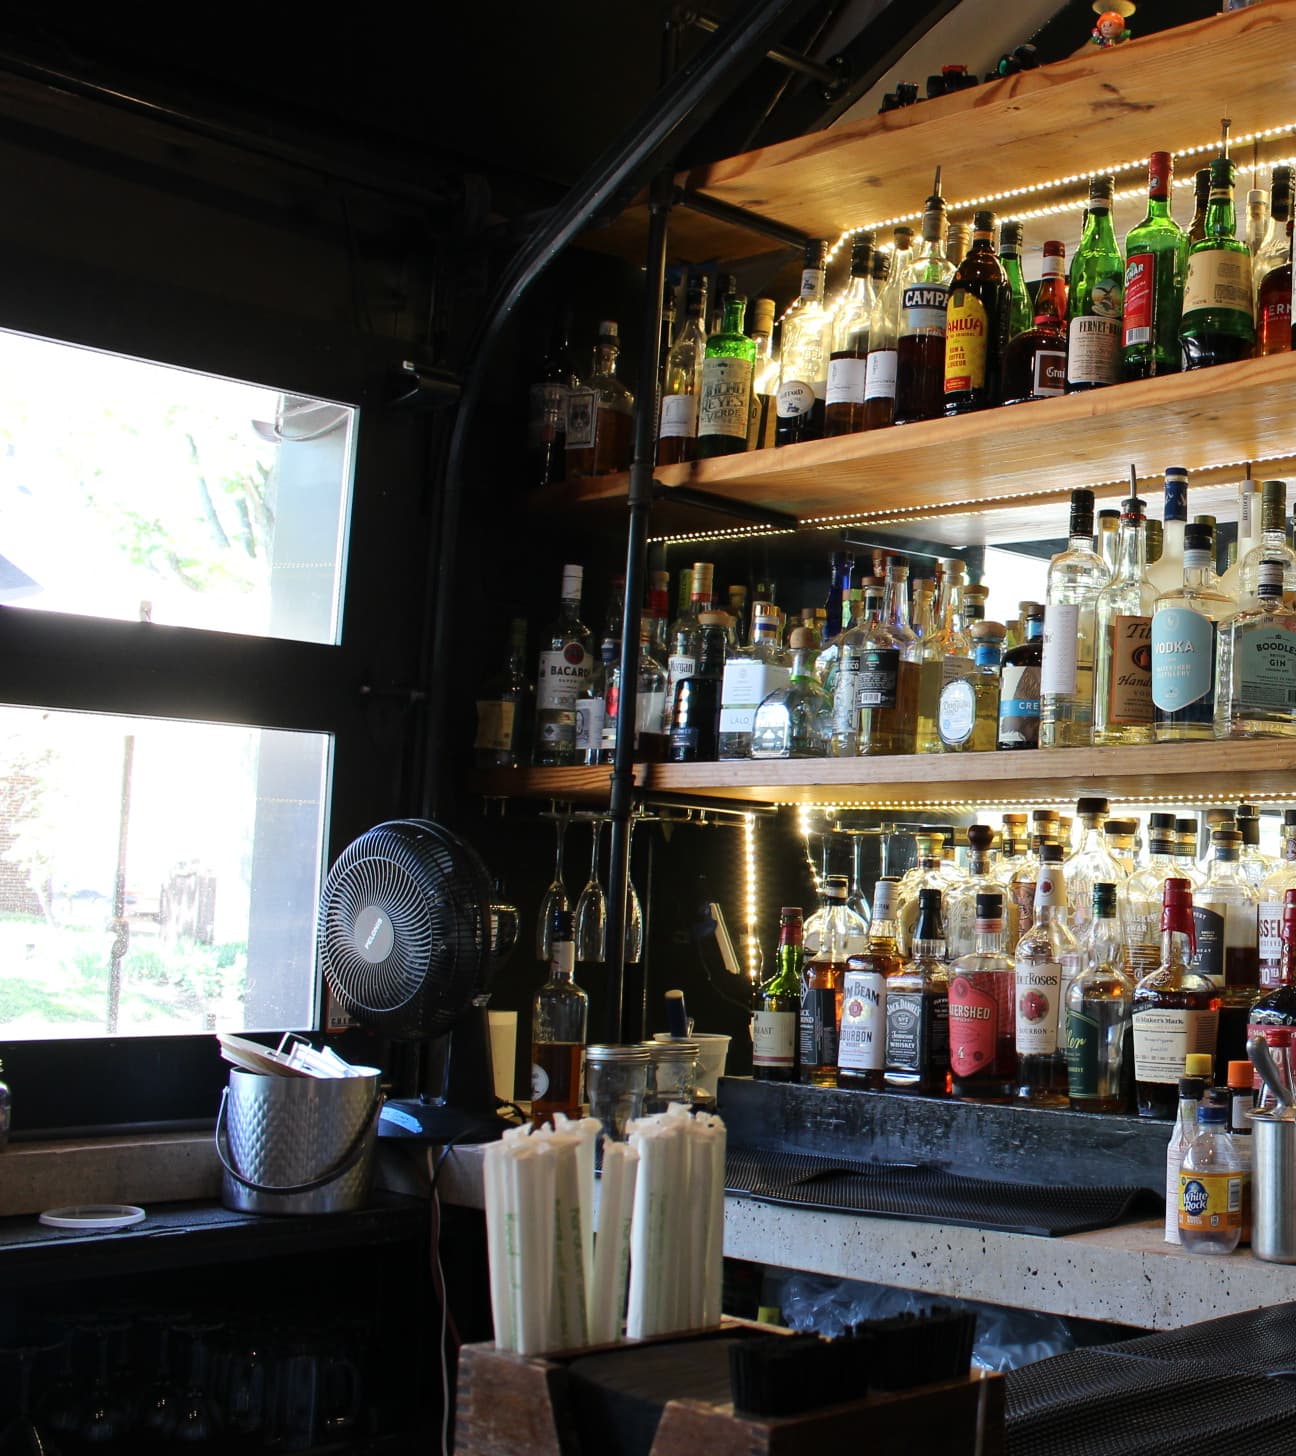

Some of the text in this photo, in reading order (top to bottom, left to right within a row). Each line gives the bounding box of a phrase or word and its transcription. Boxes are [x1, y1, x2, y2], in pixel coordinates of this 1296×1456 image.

[946, 314, 984, 337] AHLÚA
[1155, 641, 1195, 655] VODKA
[1269, 659, 1287, 667] GIN
[1030, 972, 1058, 986] Roses
[1261, 968, 1270, 985] 10
[854, 982, 880, 1008] BEAM
[1141, 1015, 1184, 1025] Maker's Mark
[1183, 1191, 1209, 1205] White
[1185, 1200, 1207, 1212] Rock
